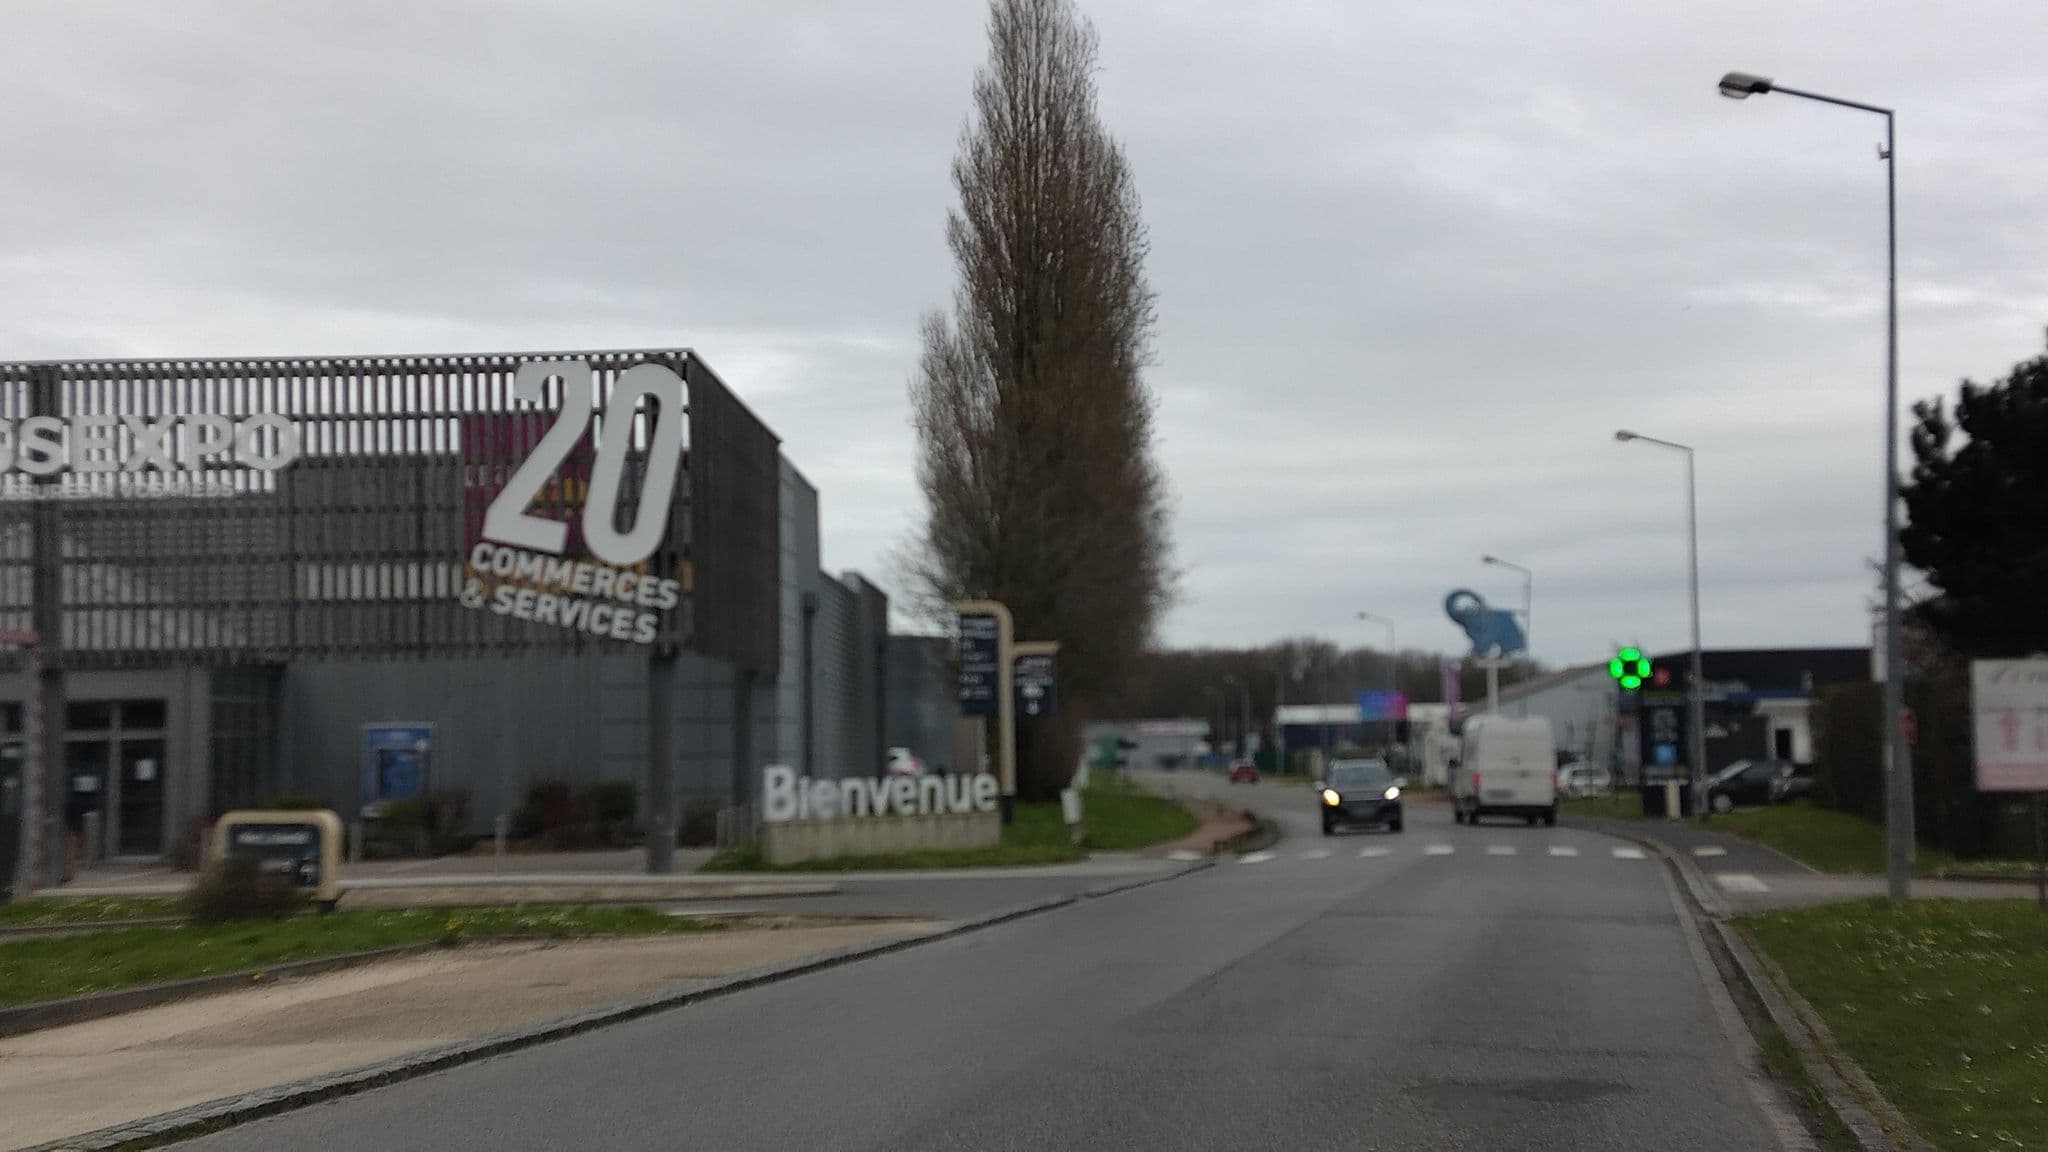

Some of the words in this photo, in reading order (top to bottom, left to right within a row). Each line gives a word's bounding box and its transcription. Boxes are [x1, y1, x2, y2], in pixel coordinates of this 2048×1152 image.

[0, 413, 300, 474] SEXPO
[481, 361, 689, 566] 20
[469, 542, 680, 610] COMMERCES
[460, 578, 485, 609] &
[491, 584, 658, 644] SERVICES
[763, 764, 999, 822] Bienvenue
